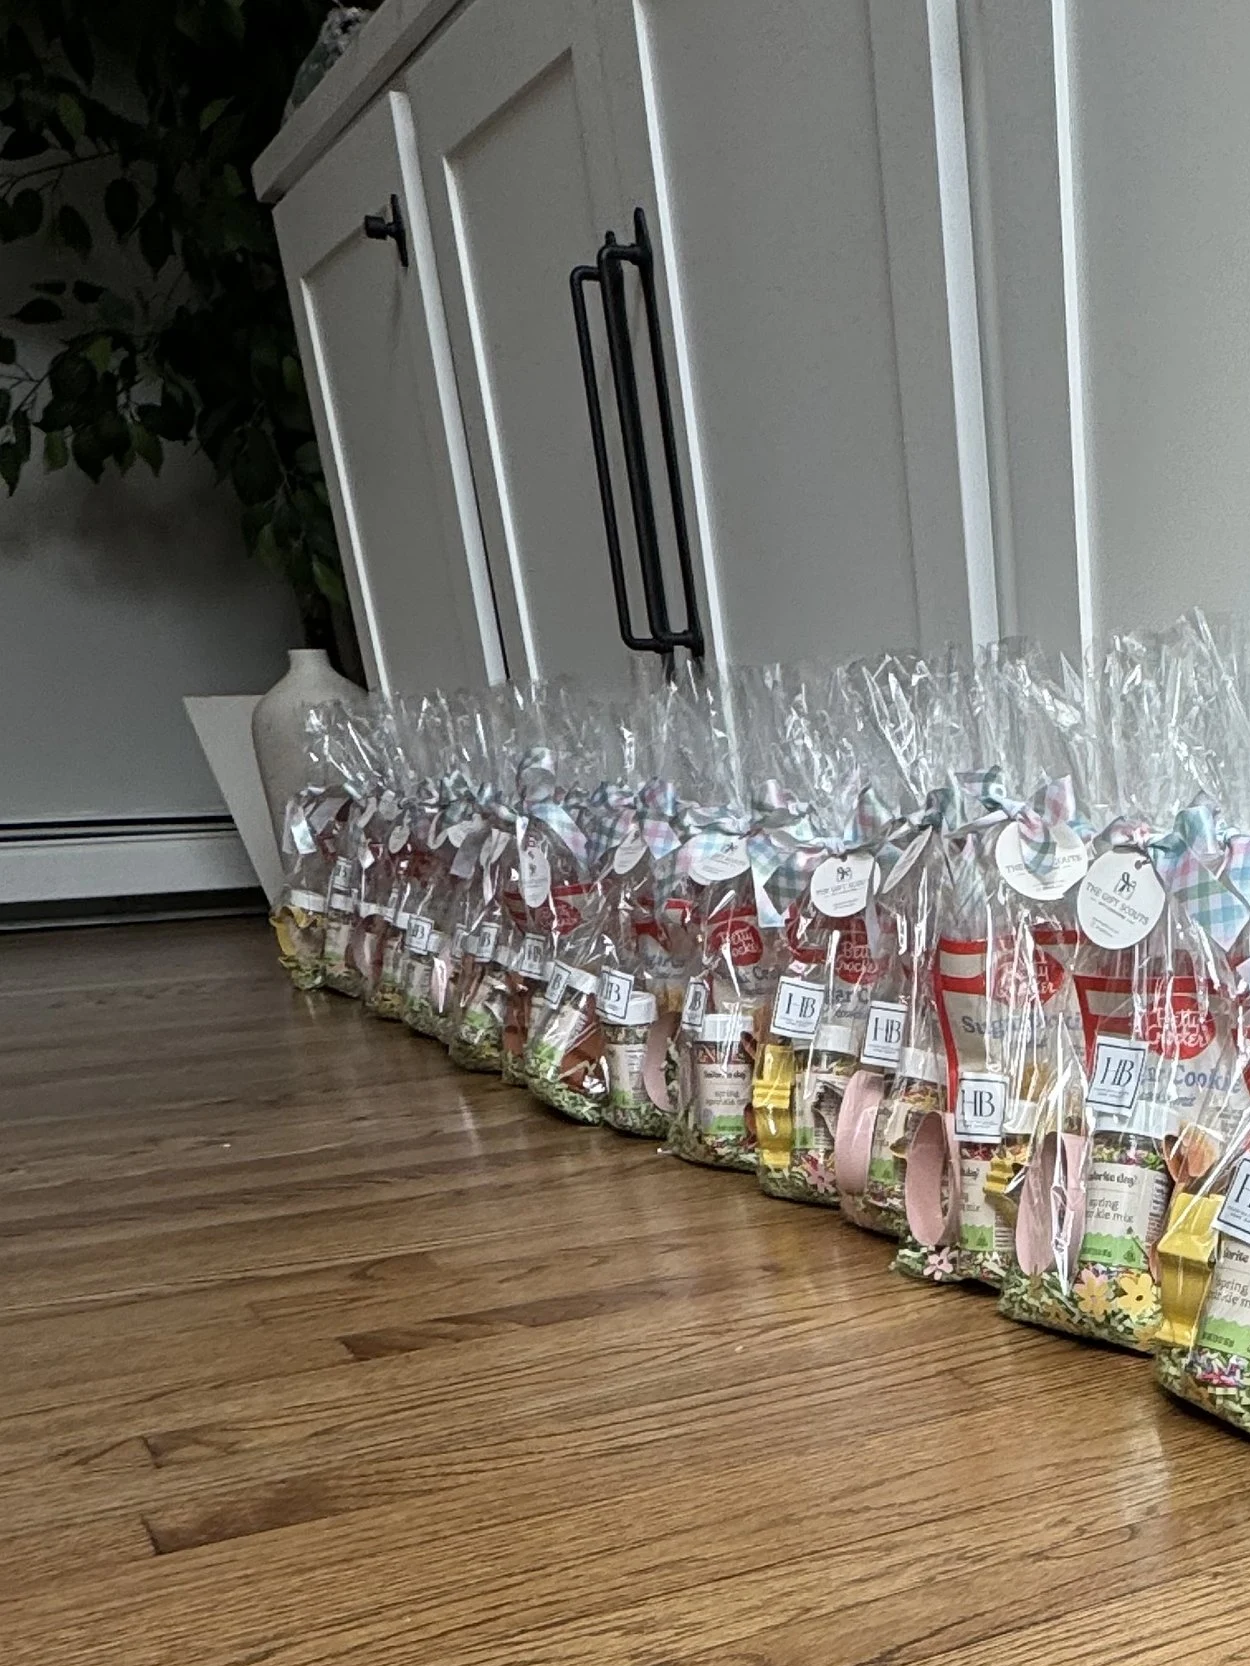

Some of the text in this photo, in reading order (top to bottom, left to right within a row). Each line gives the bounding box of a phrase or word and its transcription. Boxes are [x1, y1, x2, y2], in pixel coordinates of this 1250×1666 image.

[1119, 902, 1150, 926] SCOUTS
[785, 992, 817, 1019] HB
[873, 1016, 902, 1044] HB
[1100, 1056, 1135, 1088] HB
[961, 1089, 996, 1118] HB
